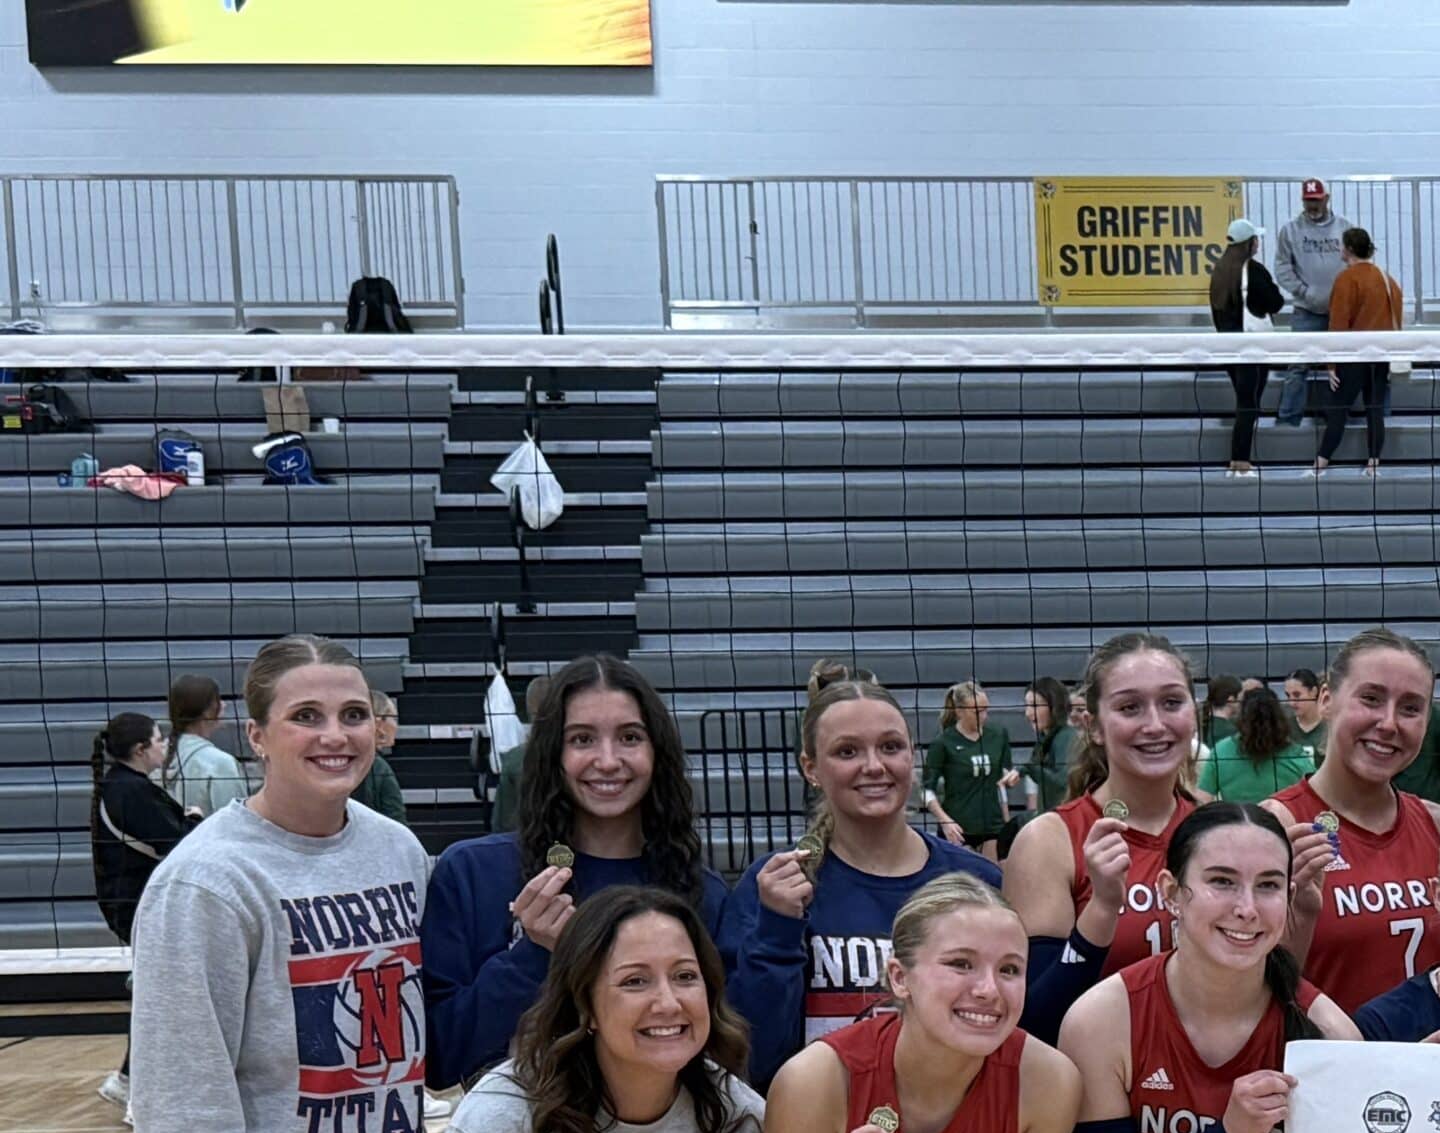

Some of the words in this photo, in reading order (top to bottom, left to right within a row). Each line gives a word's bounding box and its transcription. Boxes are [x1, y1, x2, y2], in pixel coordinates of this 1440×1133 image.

[1077, 206, 1202, 238] GRIFFIN
[1059, 244, 1222, 277] STUDENTS
[1334, 878, 1440, 916] NORR
[1390, 917, 1424, 979] 7
[353, 961, 406, 1068] N
[1140, 1081, 1175, 1091] adidas
